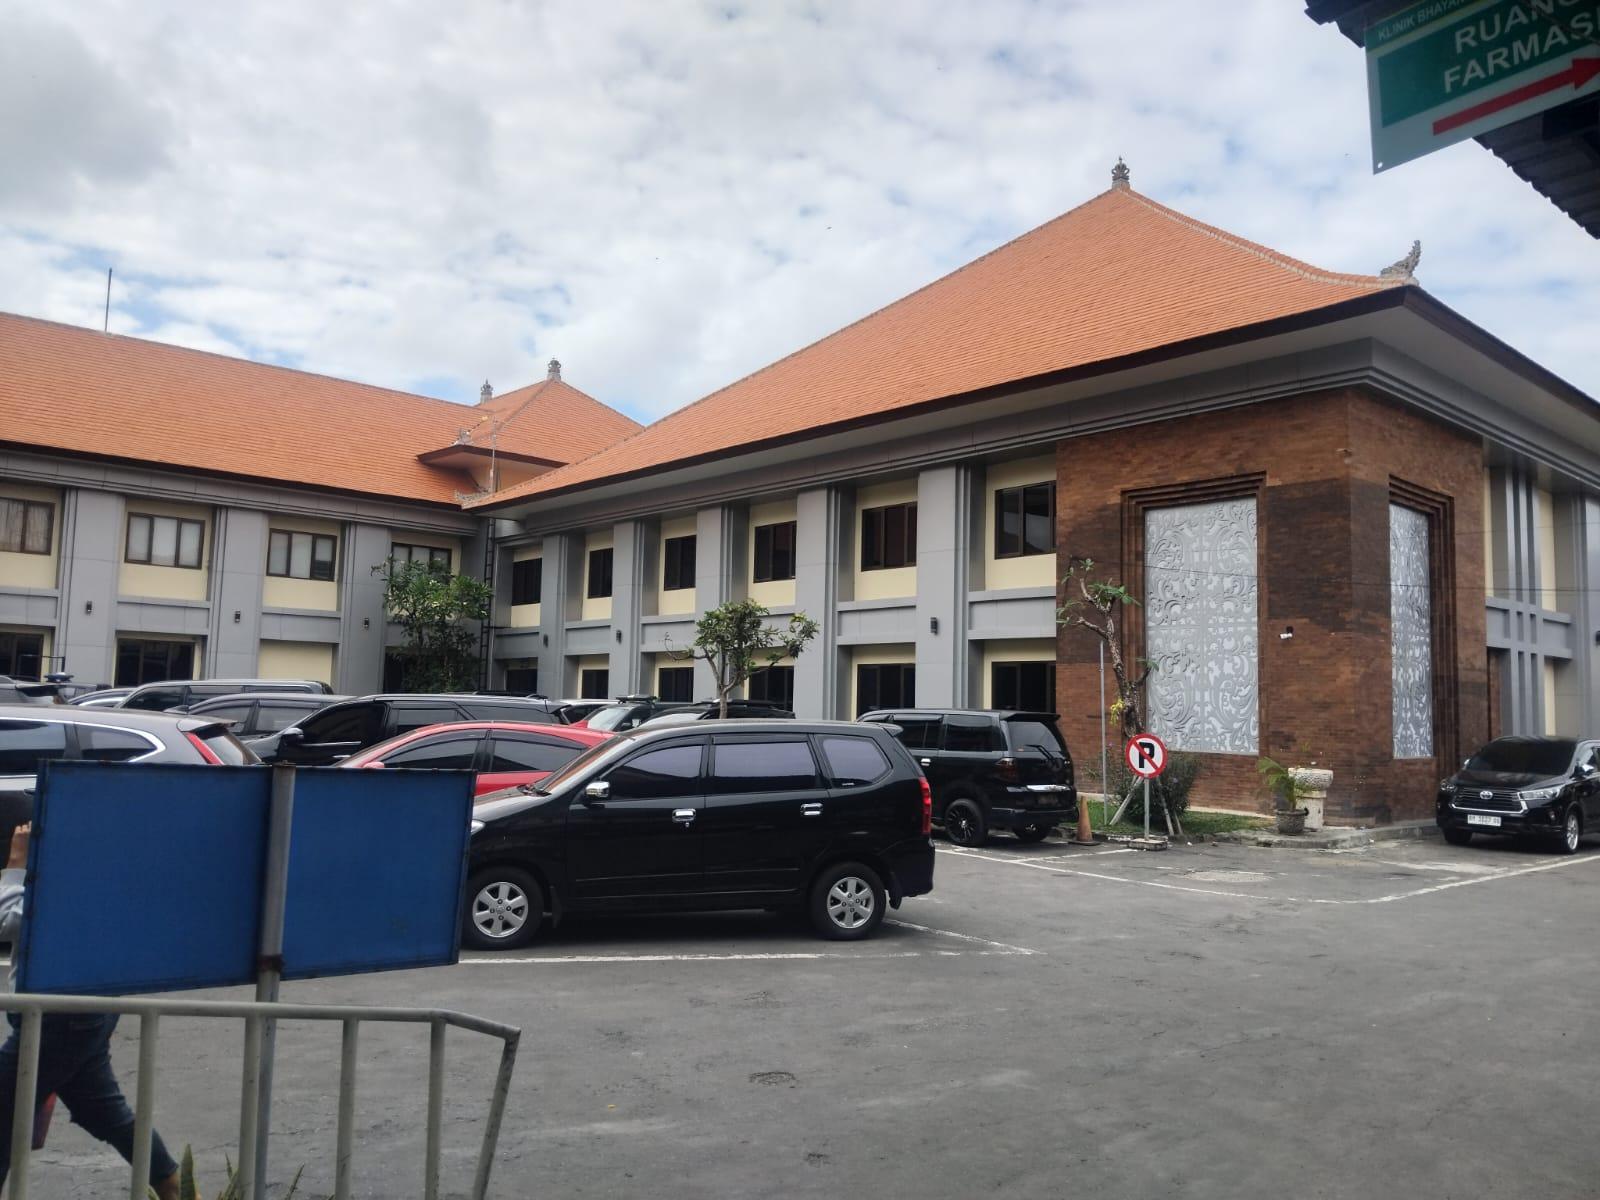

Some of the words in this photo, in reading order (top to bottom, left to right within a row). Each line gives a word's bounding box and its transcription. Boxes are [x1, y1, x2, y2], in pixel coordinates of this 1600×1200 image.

[1378, 14, 1415, 41] KLINIK
[1455, 0, 1580, 54] RUAN
[1138, 742, 1155, 768] P
